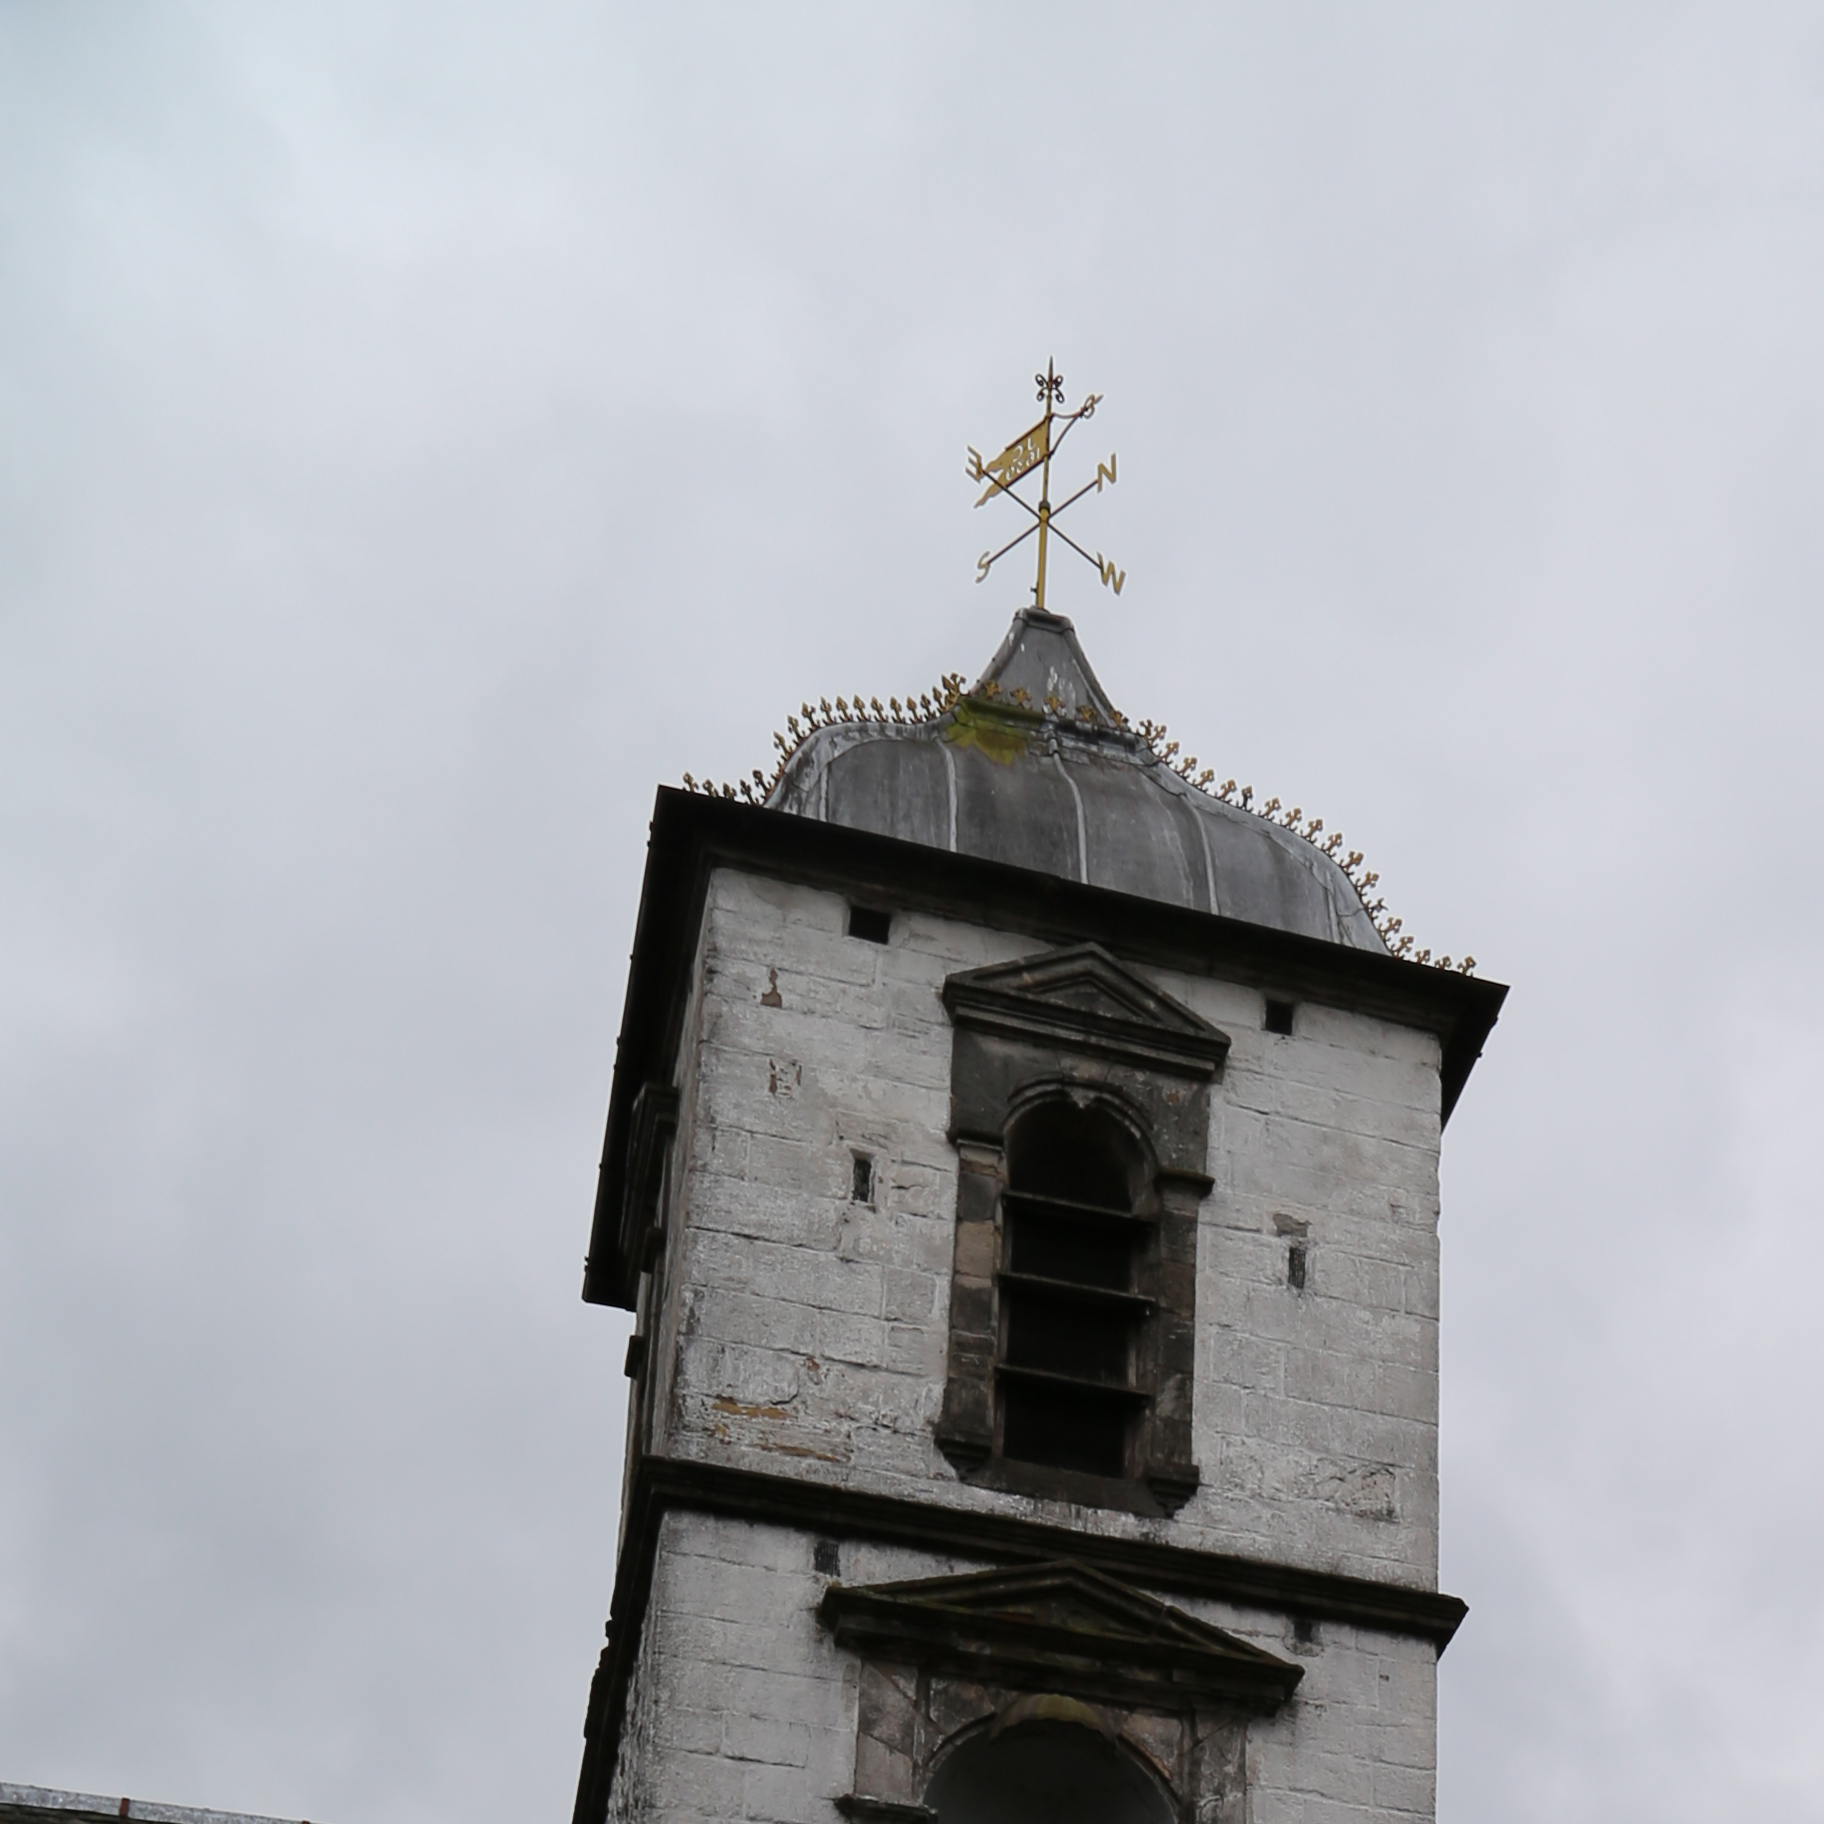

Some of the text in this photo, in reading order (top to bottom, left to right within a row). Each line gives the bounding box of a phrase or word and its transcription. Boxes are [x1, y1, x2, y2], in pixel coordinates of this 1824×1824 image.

[1098, 453, 1117, 492] N
[975, 552, 990, 583] S
[1097, 552, 1126, 595] W
